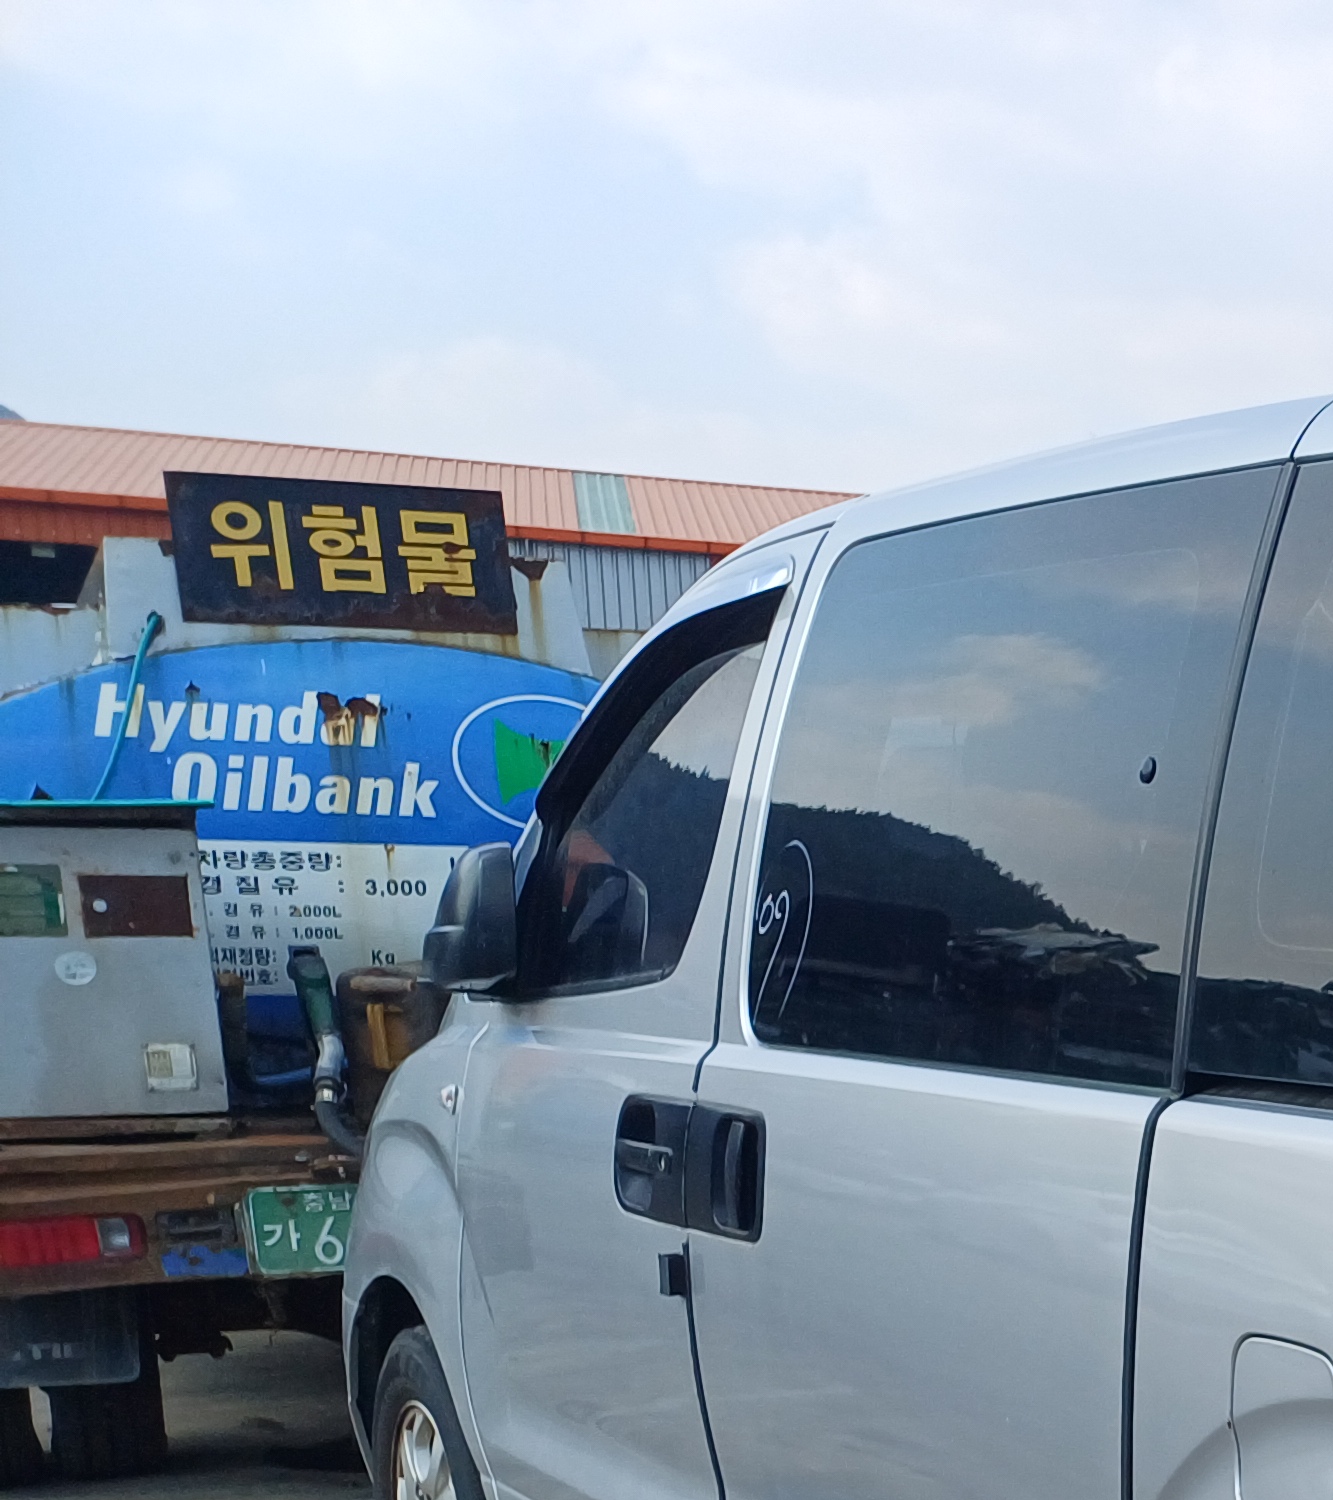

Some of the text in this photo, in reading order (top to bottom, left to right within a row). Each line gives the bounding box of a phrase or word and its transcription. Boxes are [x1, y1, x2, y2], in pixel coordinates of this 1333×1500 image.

[210, 500, 477, 597] 위험물
[94, 682, 381, 753] Hyundai
[171, 752, 440, 819] Oilbank
[365, 879, 427, 897] 3,000
